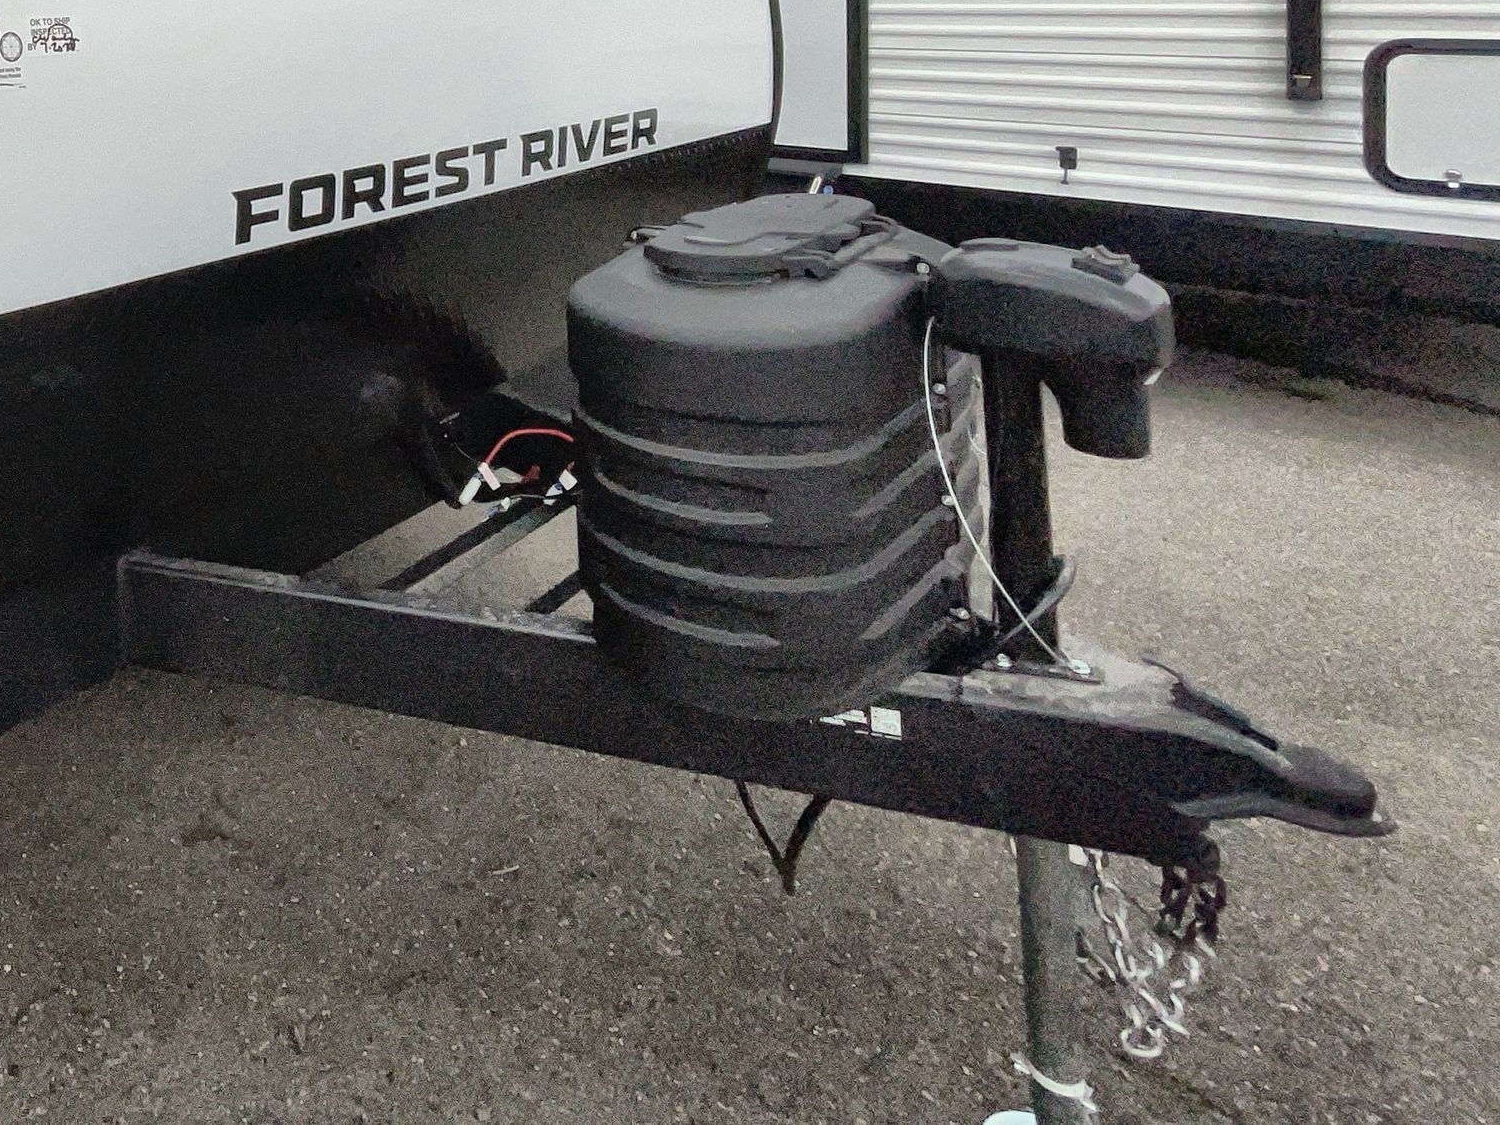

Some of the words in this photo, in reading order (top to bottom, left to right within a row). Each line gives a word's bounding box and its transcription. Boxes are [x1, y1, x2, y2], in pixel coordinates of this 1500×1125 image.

[29, 18, 41, 27] OK
[42, 17, 53, 26] TO
[53, 16, 71, 25] SHIP
[231, 137, 508, 246] FOREST
[519, 108, 658, 177] RIVER
